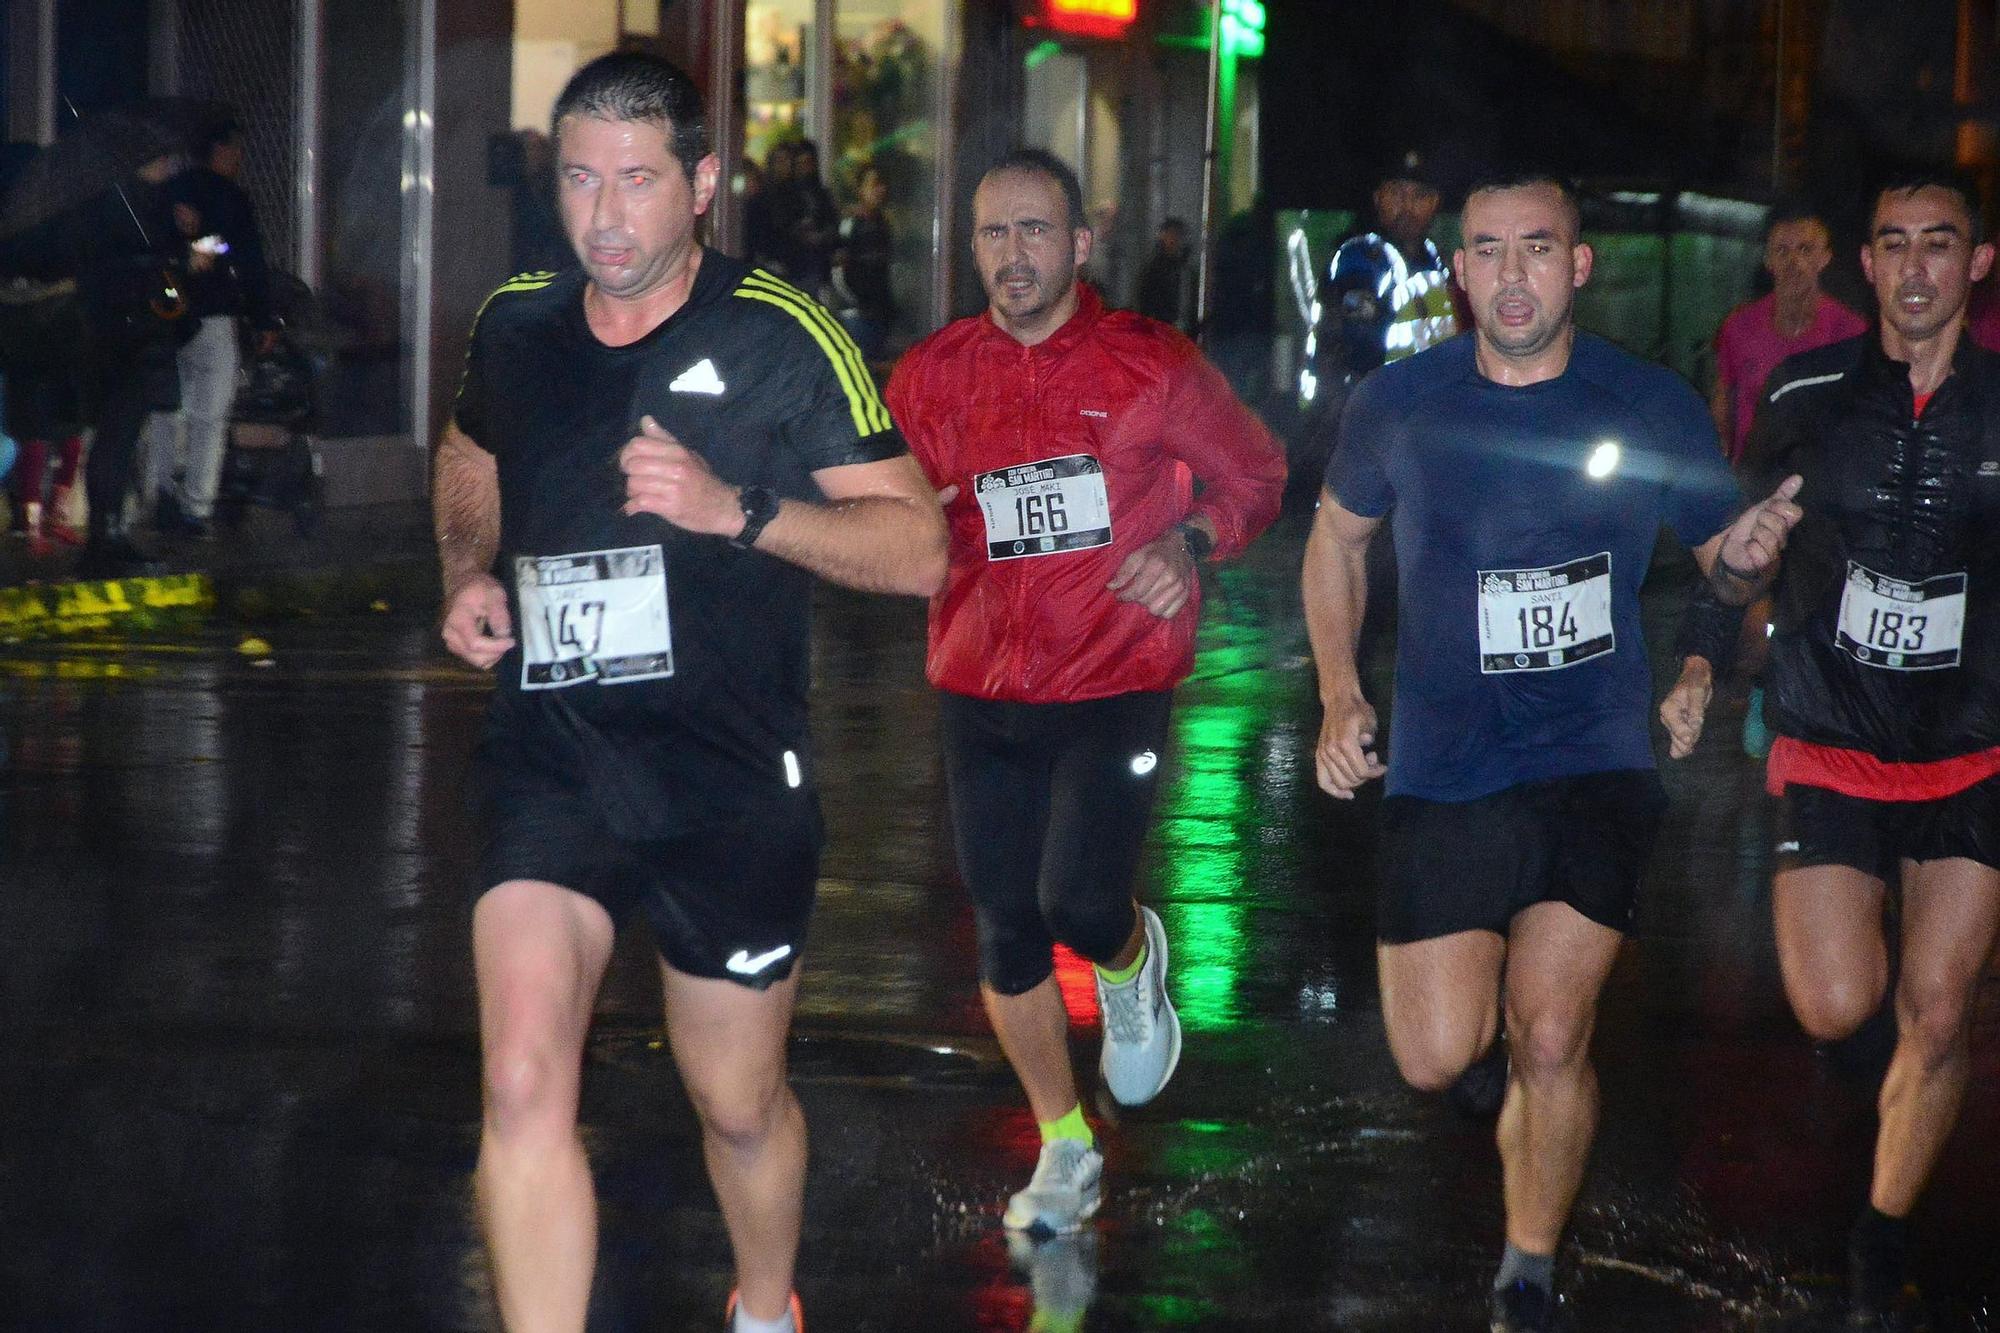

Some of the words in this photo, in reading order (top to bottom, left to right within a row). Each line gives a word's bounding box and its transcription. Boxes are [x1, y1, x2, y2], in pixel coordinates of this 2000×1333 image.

[1008, 475, 1024, 486] SAN
[1015, 492, 1069, 537] 166
[545, 600, 606, 658] 147
[1518, 601, 1579, 650] 184
[1867, 607, 1927, 651] 183
